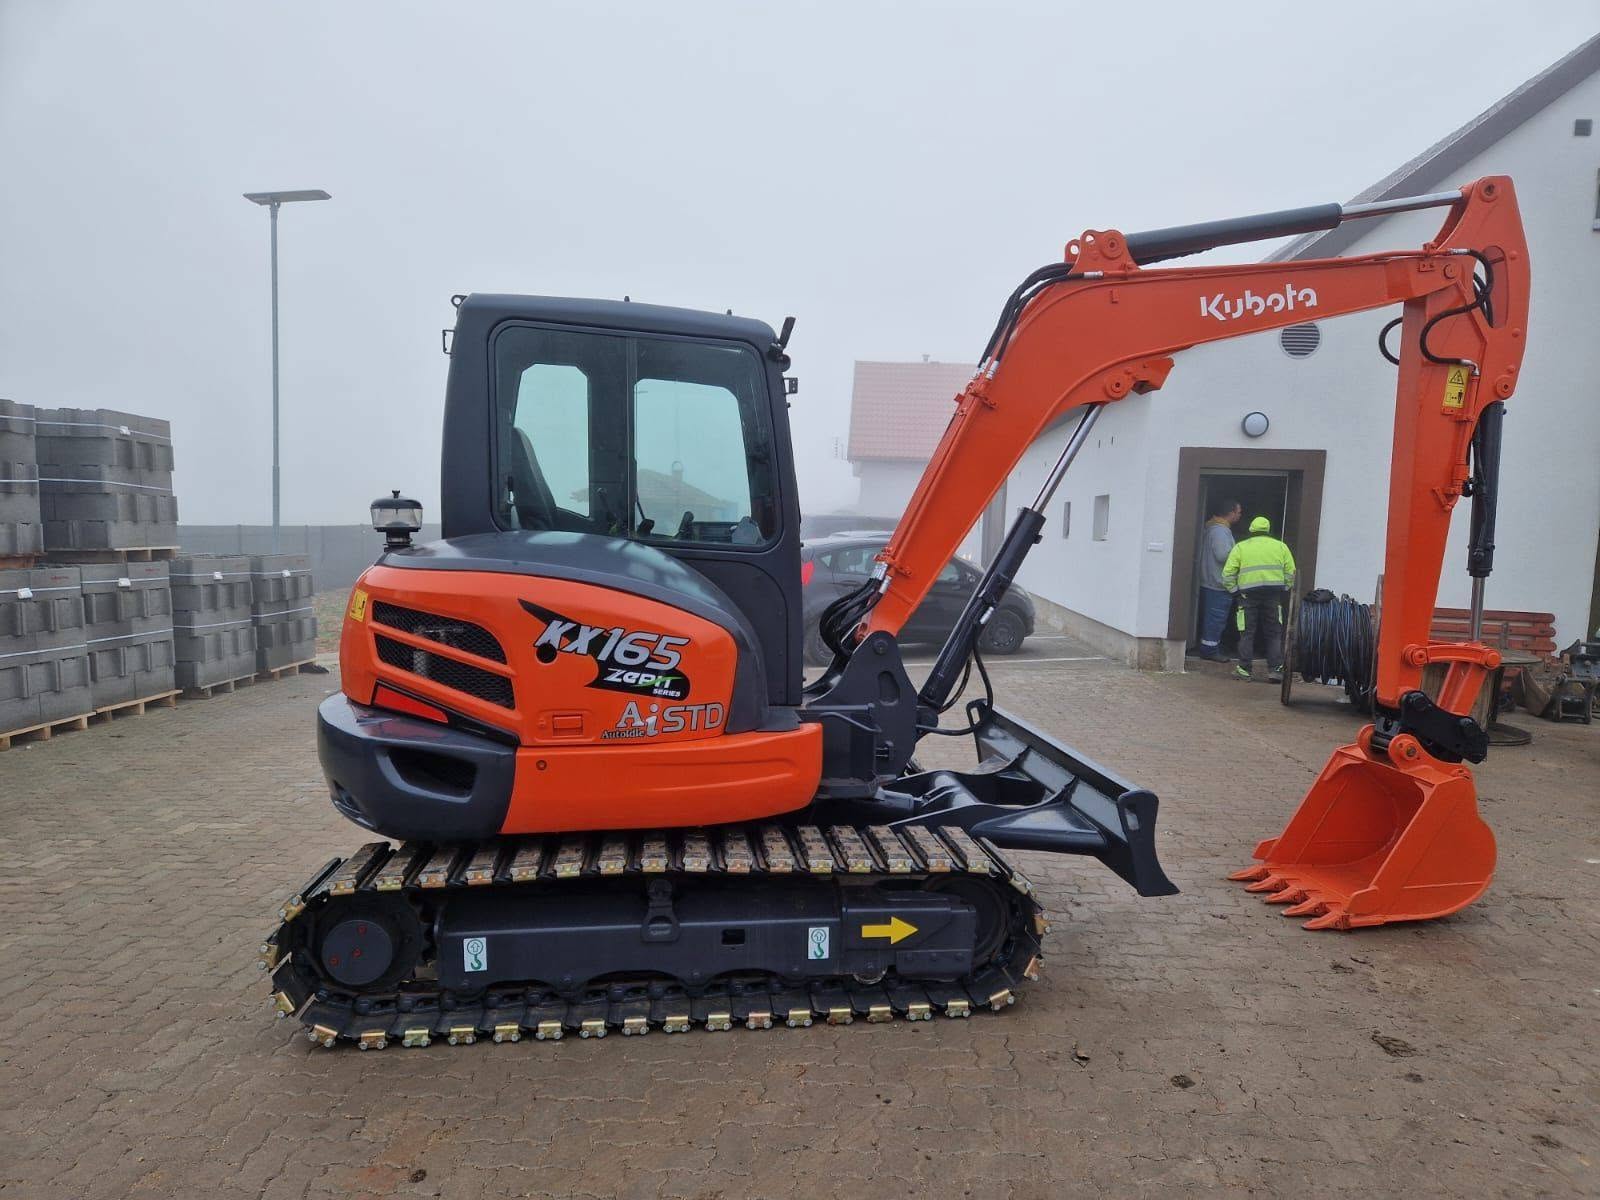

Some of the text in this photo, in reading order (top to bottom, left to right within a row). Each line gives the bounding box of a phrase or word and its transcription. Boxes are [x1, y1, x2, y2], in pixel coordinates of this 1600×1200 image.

[1200, 283, 1318, 321] Kubota
[533, 619, 691, 671] KX165
[661, 702, 725, 733] STD
